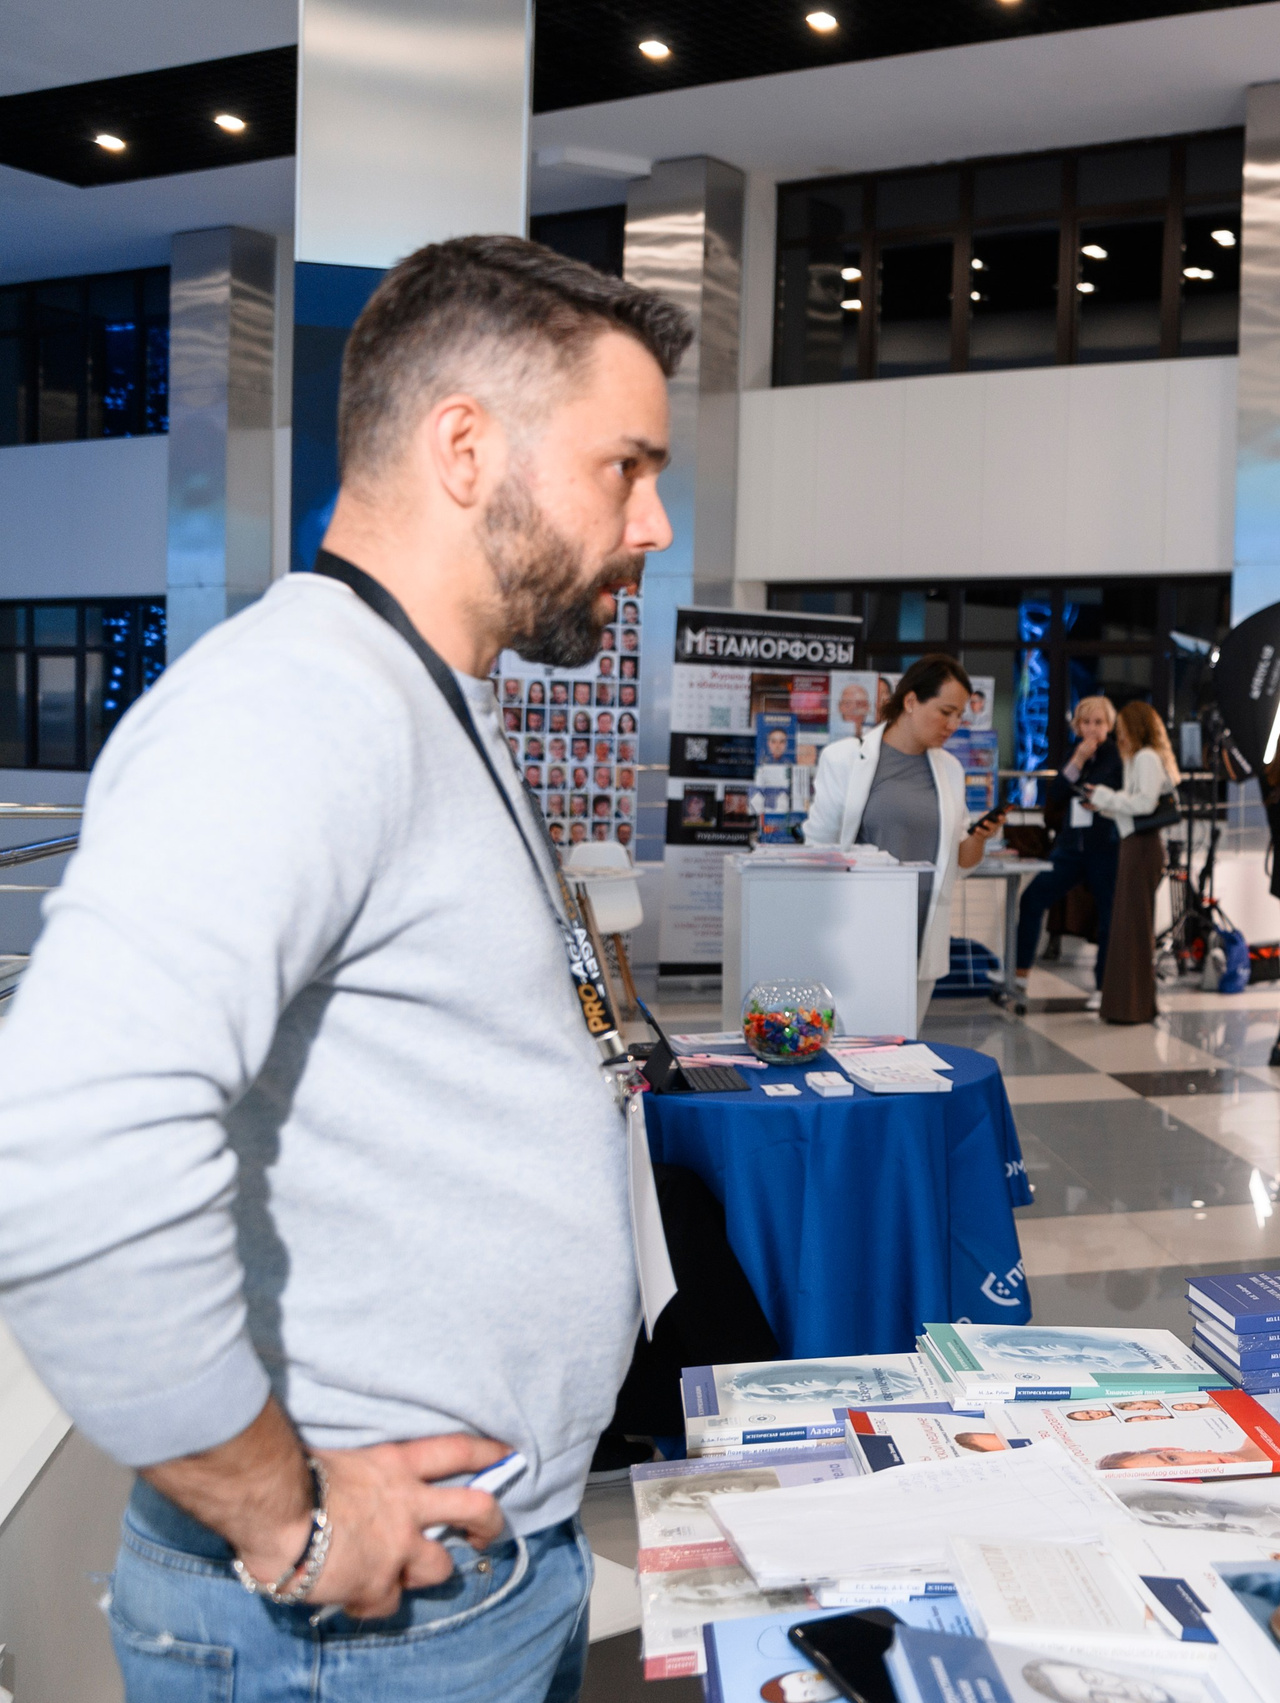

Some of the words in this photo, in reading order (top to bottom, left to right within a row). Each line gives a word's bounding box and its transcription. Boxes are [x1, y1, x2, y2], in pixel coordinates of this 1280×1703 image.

[684, 627, 855, 665] МЕТАМОРФОЗЫ
[1105, 1389, 1143, 1397] Химический
[810, 1426, 844, 1436] Лазеро-
[1179, 1467, 1225, 1477] Руководство
